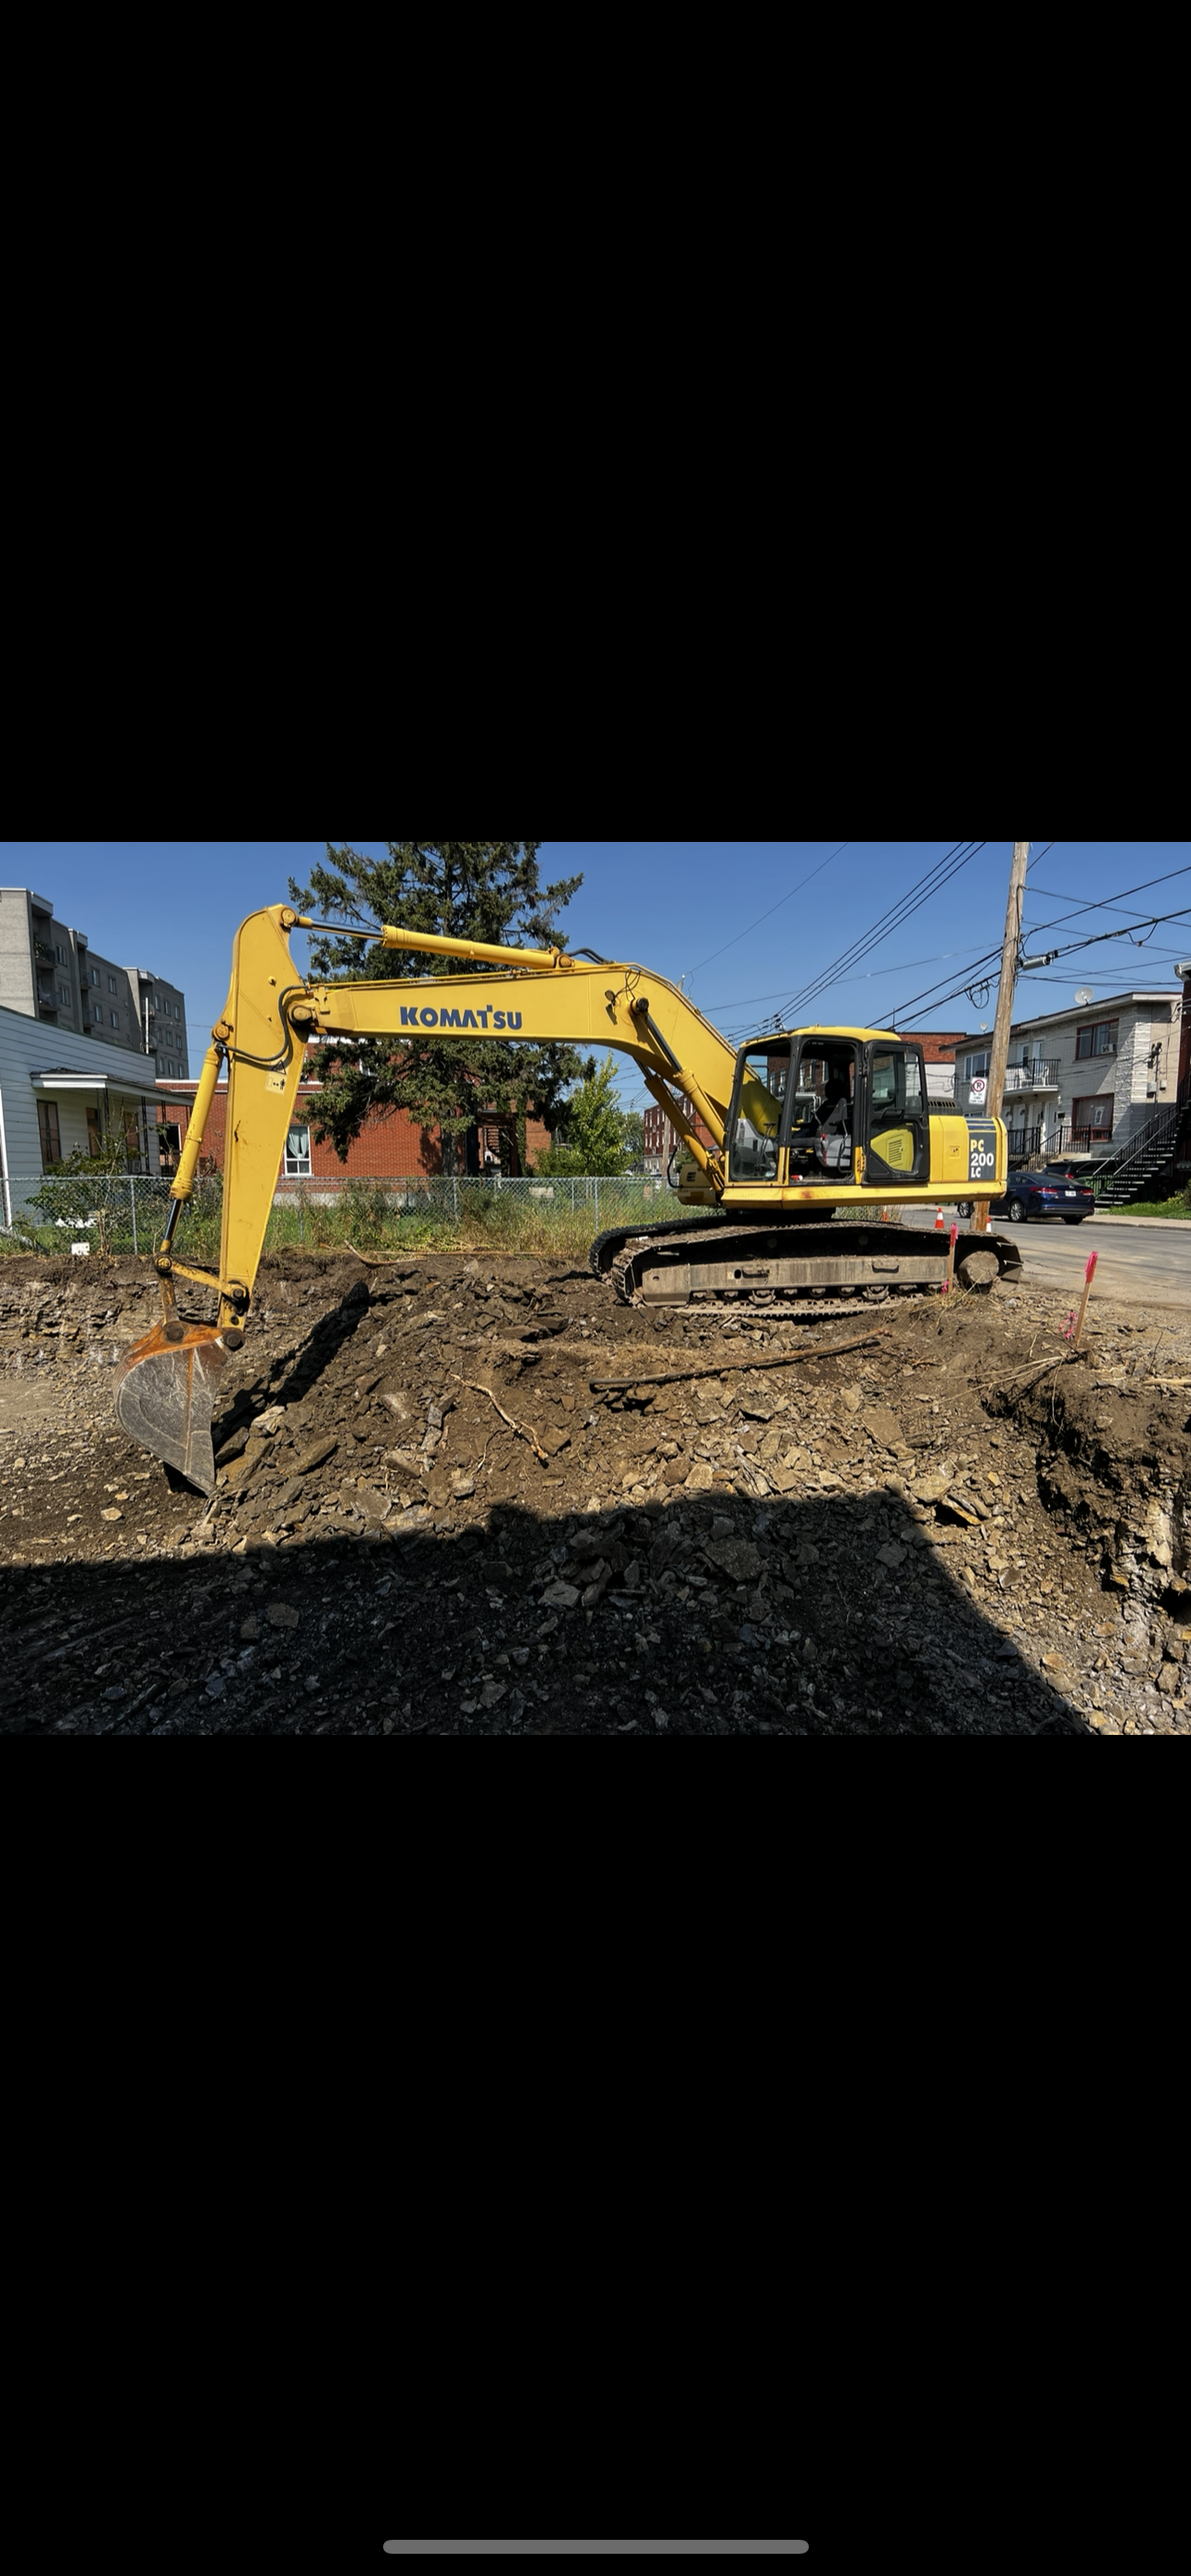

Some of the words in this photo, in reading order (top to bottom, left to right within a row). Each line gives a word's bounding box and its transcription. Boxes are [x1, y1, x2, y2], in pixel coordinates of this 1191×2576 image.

[400, 1004, 522, 1030] KOMATSU
[970, 1139, 984, 1153] PC
[970, 1153, 994, 1167] 200
[970, 1167, 981, 1179] LC
